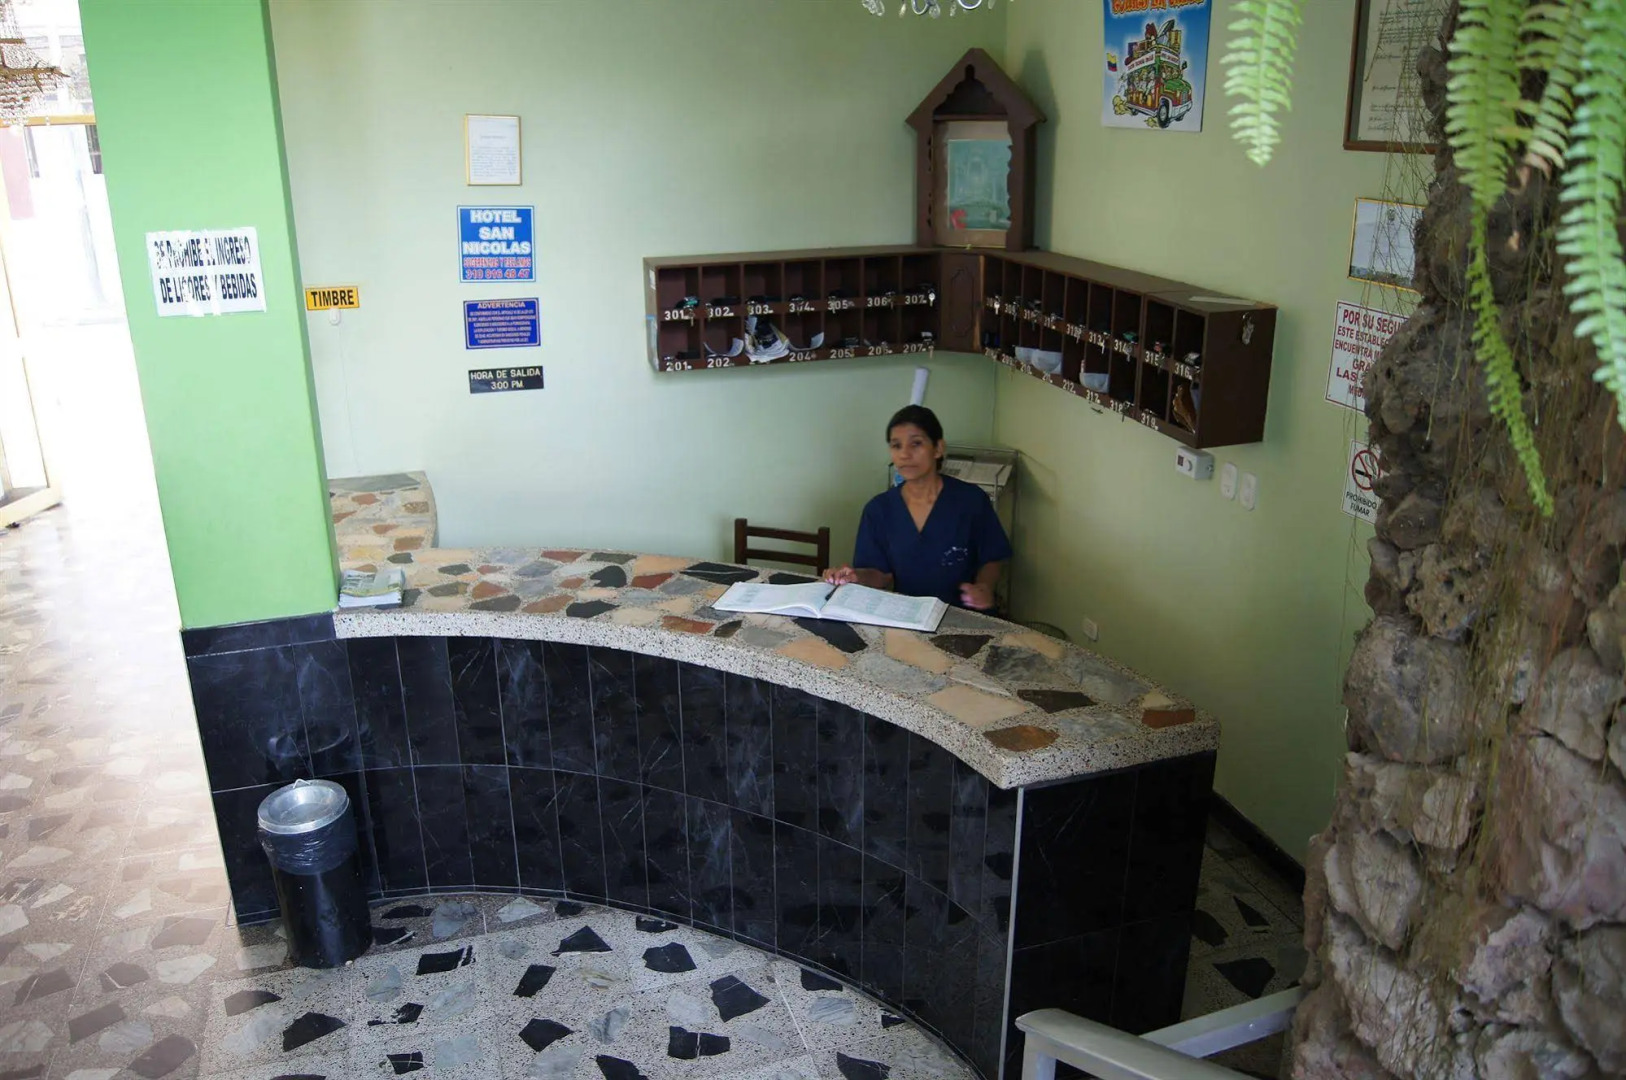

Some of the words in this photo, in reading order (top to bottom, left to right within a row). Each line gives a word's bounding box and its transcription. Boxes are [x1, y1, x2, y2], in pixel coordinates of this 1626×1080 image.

[470, 209, 522, 223] HOTEL
[479, 226, 514, 240] SAN
[215, 236, 251, 266] INGRESO
[462, 241, 531, 255] NICOLAS
[466, 268, 483, 279] 310
[517, 268, 530, 278] 47
[159, 278, 174, 303] DE
[220, 273, 257, 299] BEBIDAS
[310, 289, 355, 307] TIMBRE
[477, 301, 526, 309] ADVERTENCIA
[827, 300, 848, 310] 305
[867, 297, 888, 307] 306
[905, 294, 924, 304] 307
[664, 309, 684, 320] 301
[708, 307, 730, 317] 302
[748, 304, 769, 315] 303
[1342, 309, 1361, 327] POR
[1362, 314, 1375, 330] SU
[1376, 317, 1402, 335] SEGU
[1088, 332, 1101, 346] 313
[1337, 325, 1354, 339] ESTE
[1355, 330, 1389, 347] ESTABLEC
[830, 349, 850, 359] 205
[903, 343, 923, 353] 207
[1334, 339, 1373, 359] ENCUENTRA
[707, 357, 730, 368] 202
[789, 351, 811, 362] 204
[1145, 351, 1159, 366] 315
[666, 361, 687, 371] 201
[1174, 362, 1190, 378] 316
[1352, 359, 1371, 372] GRA
[470, 371, 494, 380] HORA
[496, 370, 508, 378] DE
[510, 368, 541, 378] SALIDA
[1336, 367, 1357, 382] LAS
[1062, 379, 1074, 393] 212
[1141, 413, 1156, 428] 319
[1346, 491, 1378, 510] PROHIBIDO
[1350, 502, 1370, 517] FUMAR
